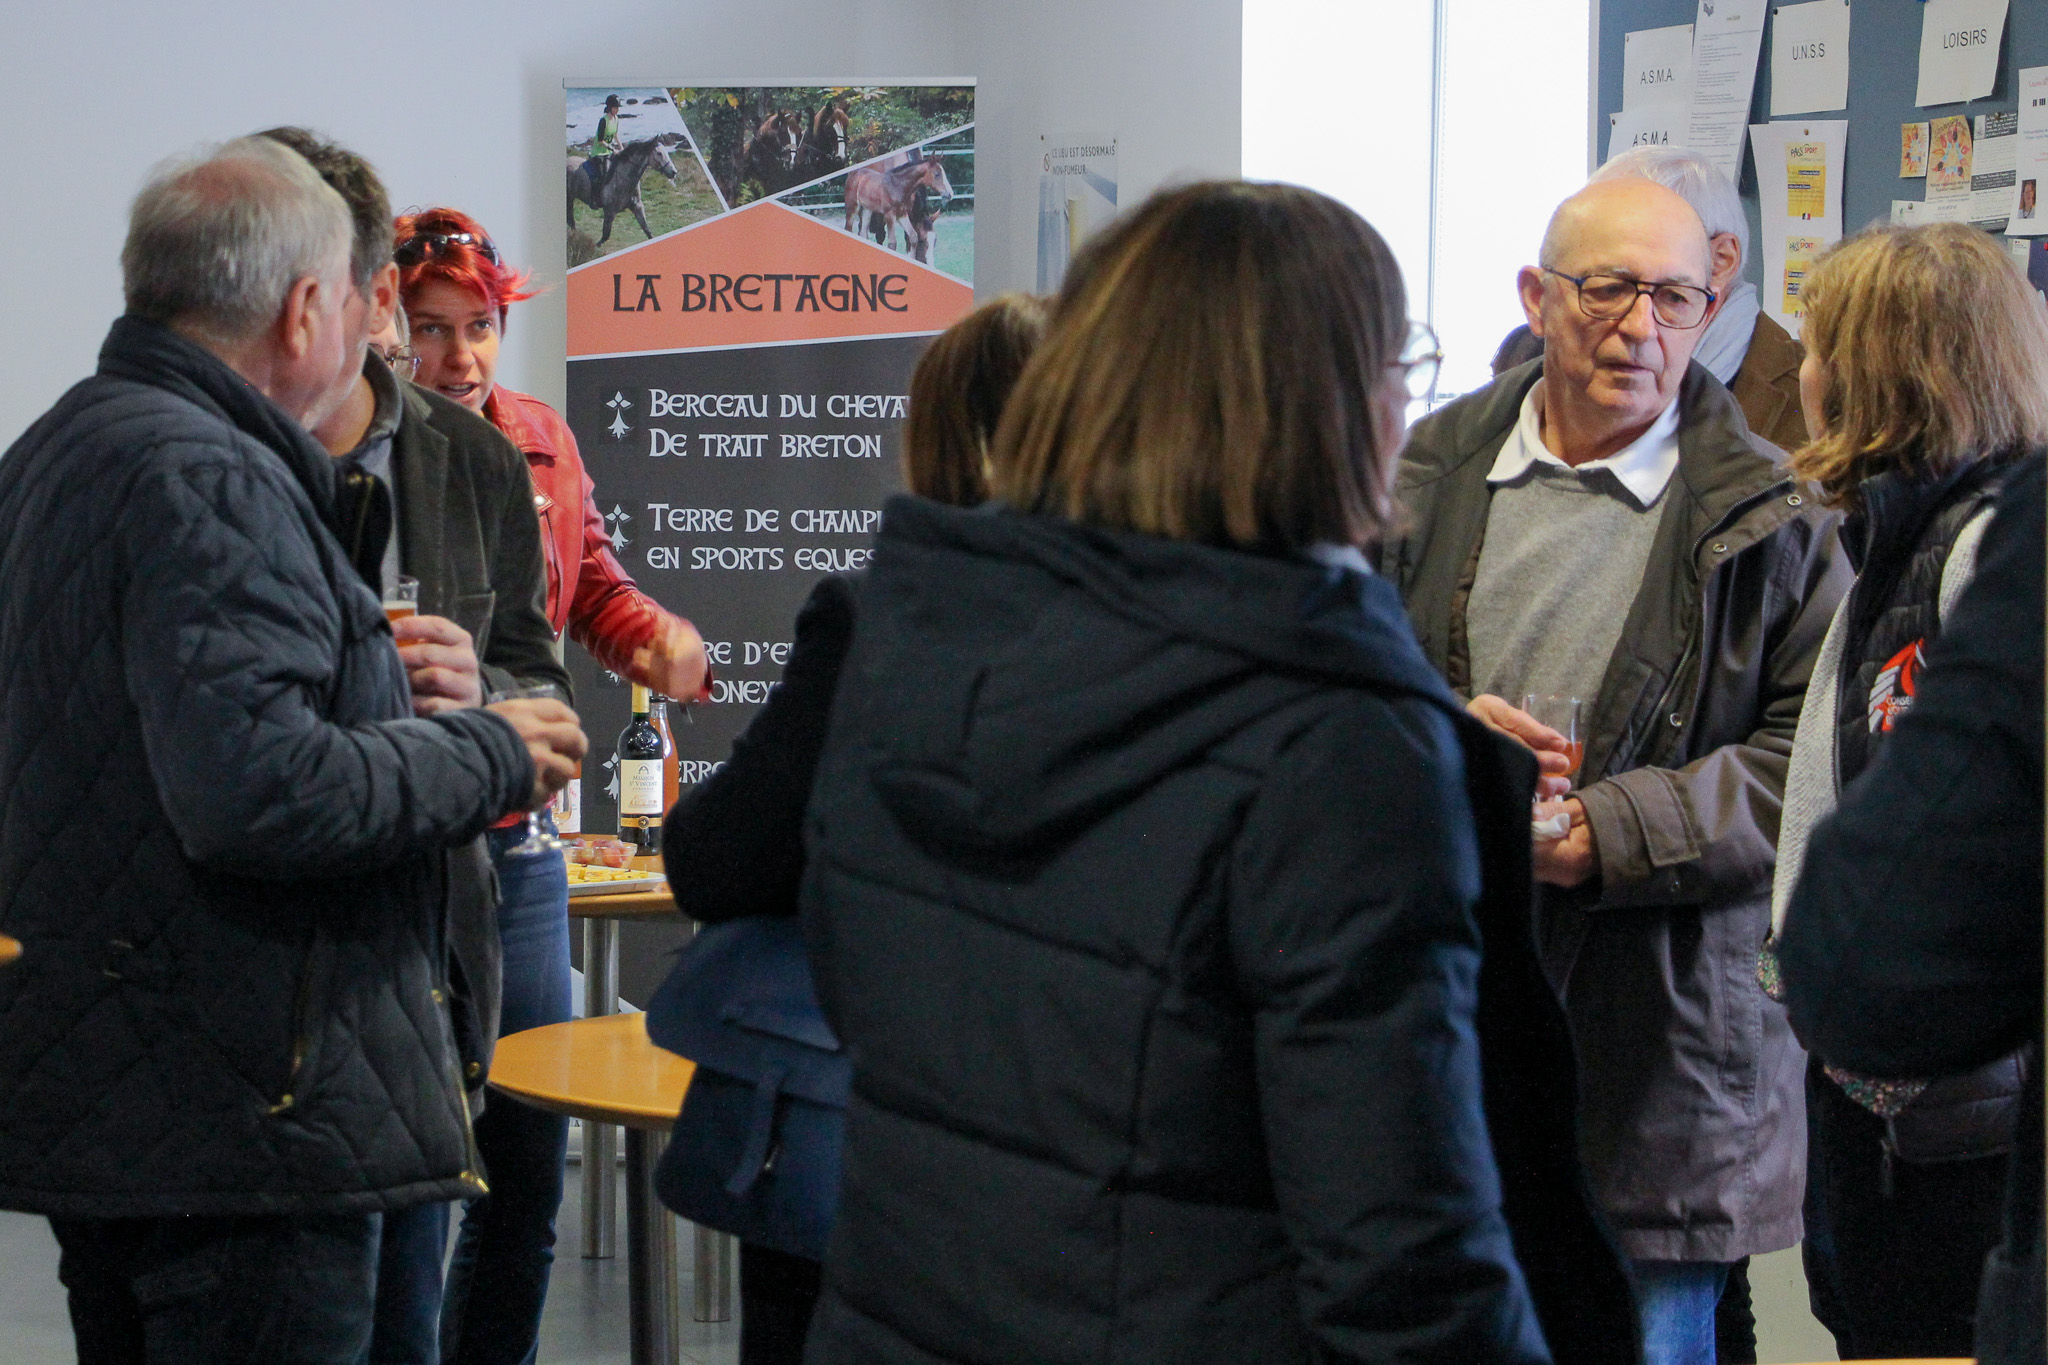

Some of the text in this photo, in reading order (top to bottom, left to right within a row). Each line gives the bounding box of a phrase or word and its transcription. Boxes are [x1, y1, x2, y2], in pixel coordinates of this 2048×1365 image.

[1943, 29, 1987, 49] LOISIRS
[1792, 43, 1826, 60] U.N.S.S
[1640, 68, 1675, 84] A.S.M.A.
[1069, 147, 1079, 158] EST
[1080, 144, 1115, 157] DÉSORMAIS
[613, 274, 908, 312] LA BRETAGNE
[648, 389, 768, 418] BERCEAU
[779, 395, 816, 418] DU
[648, 428, 881, 458] DE TRAIT BRETON
[647, 503, 733, 533] TERRE
[745, 509, 779, 533] DE
[646, 546, 680, 570] EN
[690, 547, 784, 570] SPORTS
[743, 641, 793, 665] D'E
